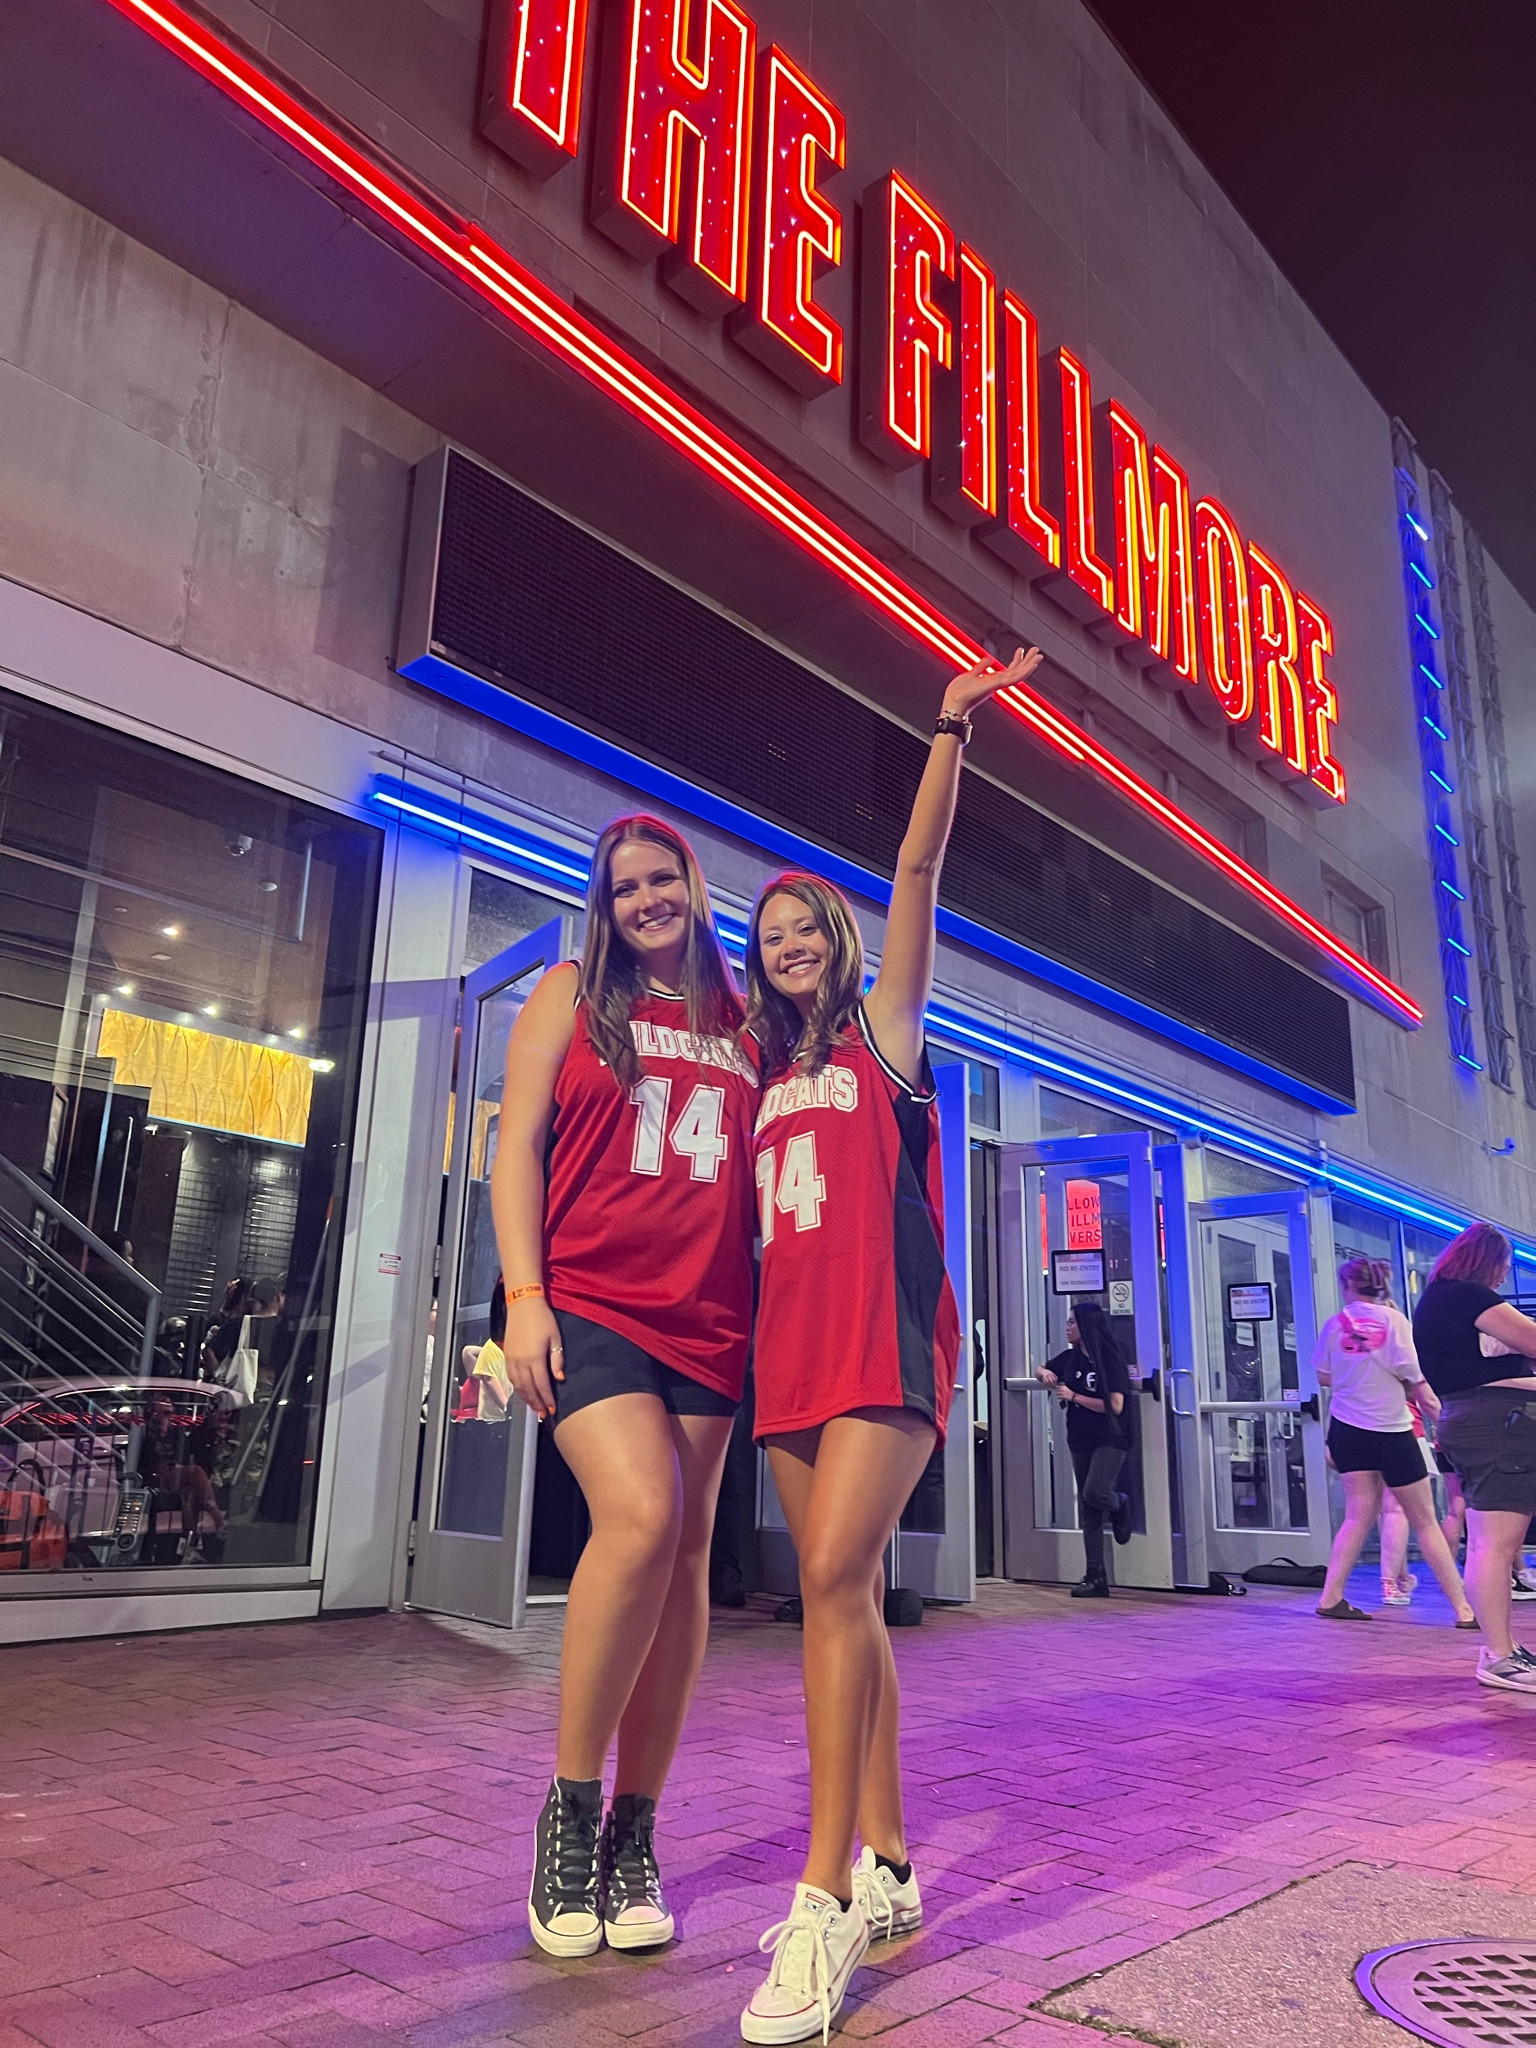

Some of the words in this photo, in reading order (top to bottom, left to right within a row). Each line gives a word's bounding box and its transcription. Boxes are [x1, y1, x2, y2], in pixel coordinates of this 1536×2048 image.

[888, 168, 1347, 805] FILLMORE
[629, 1075, 729, 1184] 14
[755, 1130, 827, 1248] 14
